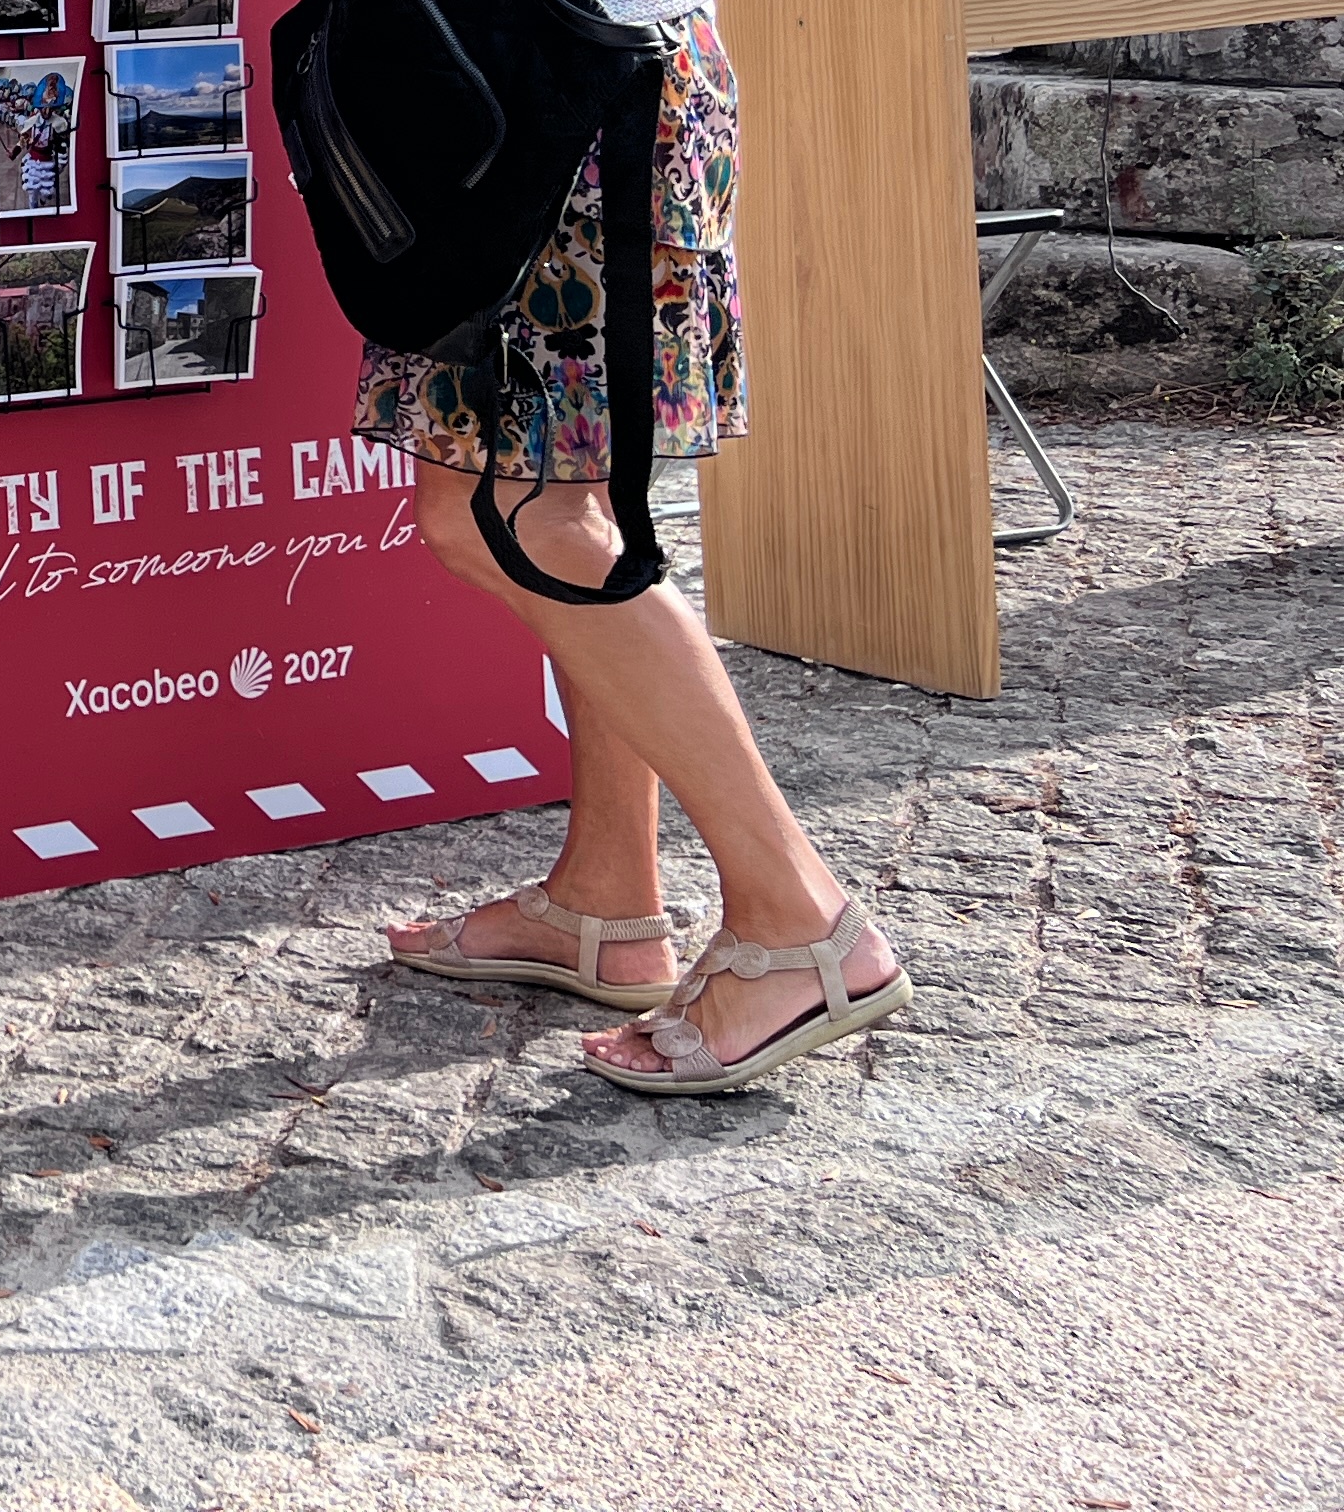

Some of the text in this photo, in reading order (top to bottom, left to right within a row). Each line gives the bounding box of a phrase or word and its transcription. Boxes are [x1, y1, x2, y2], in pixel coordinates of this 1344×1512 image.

[90, 460, 146, 525] OF
[176, 446, 264, 513] THE
[23, 543, 78, 598] to
[81, 541, 277, 589] someone
[285, 532, 368, 606] you
[65, 645, 354, 718] Xacobeo 2027
